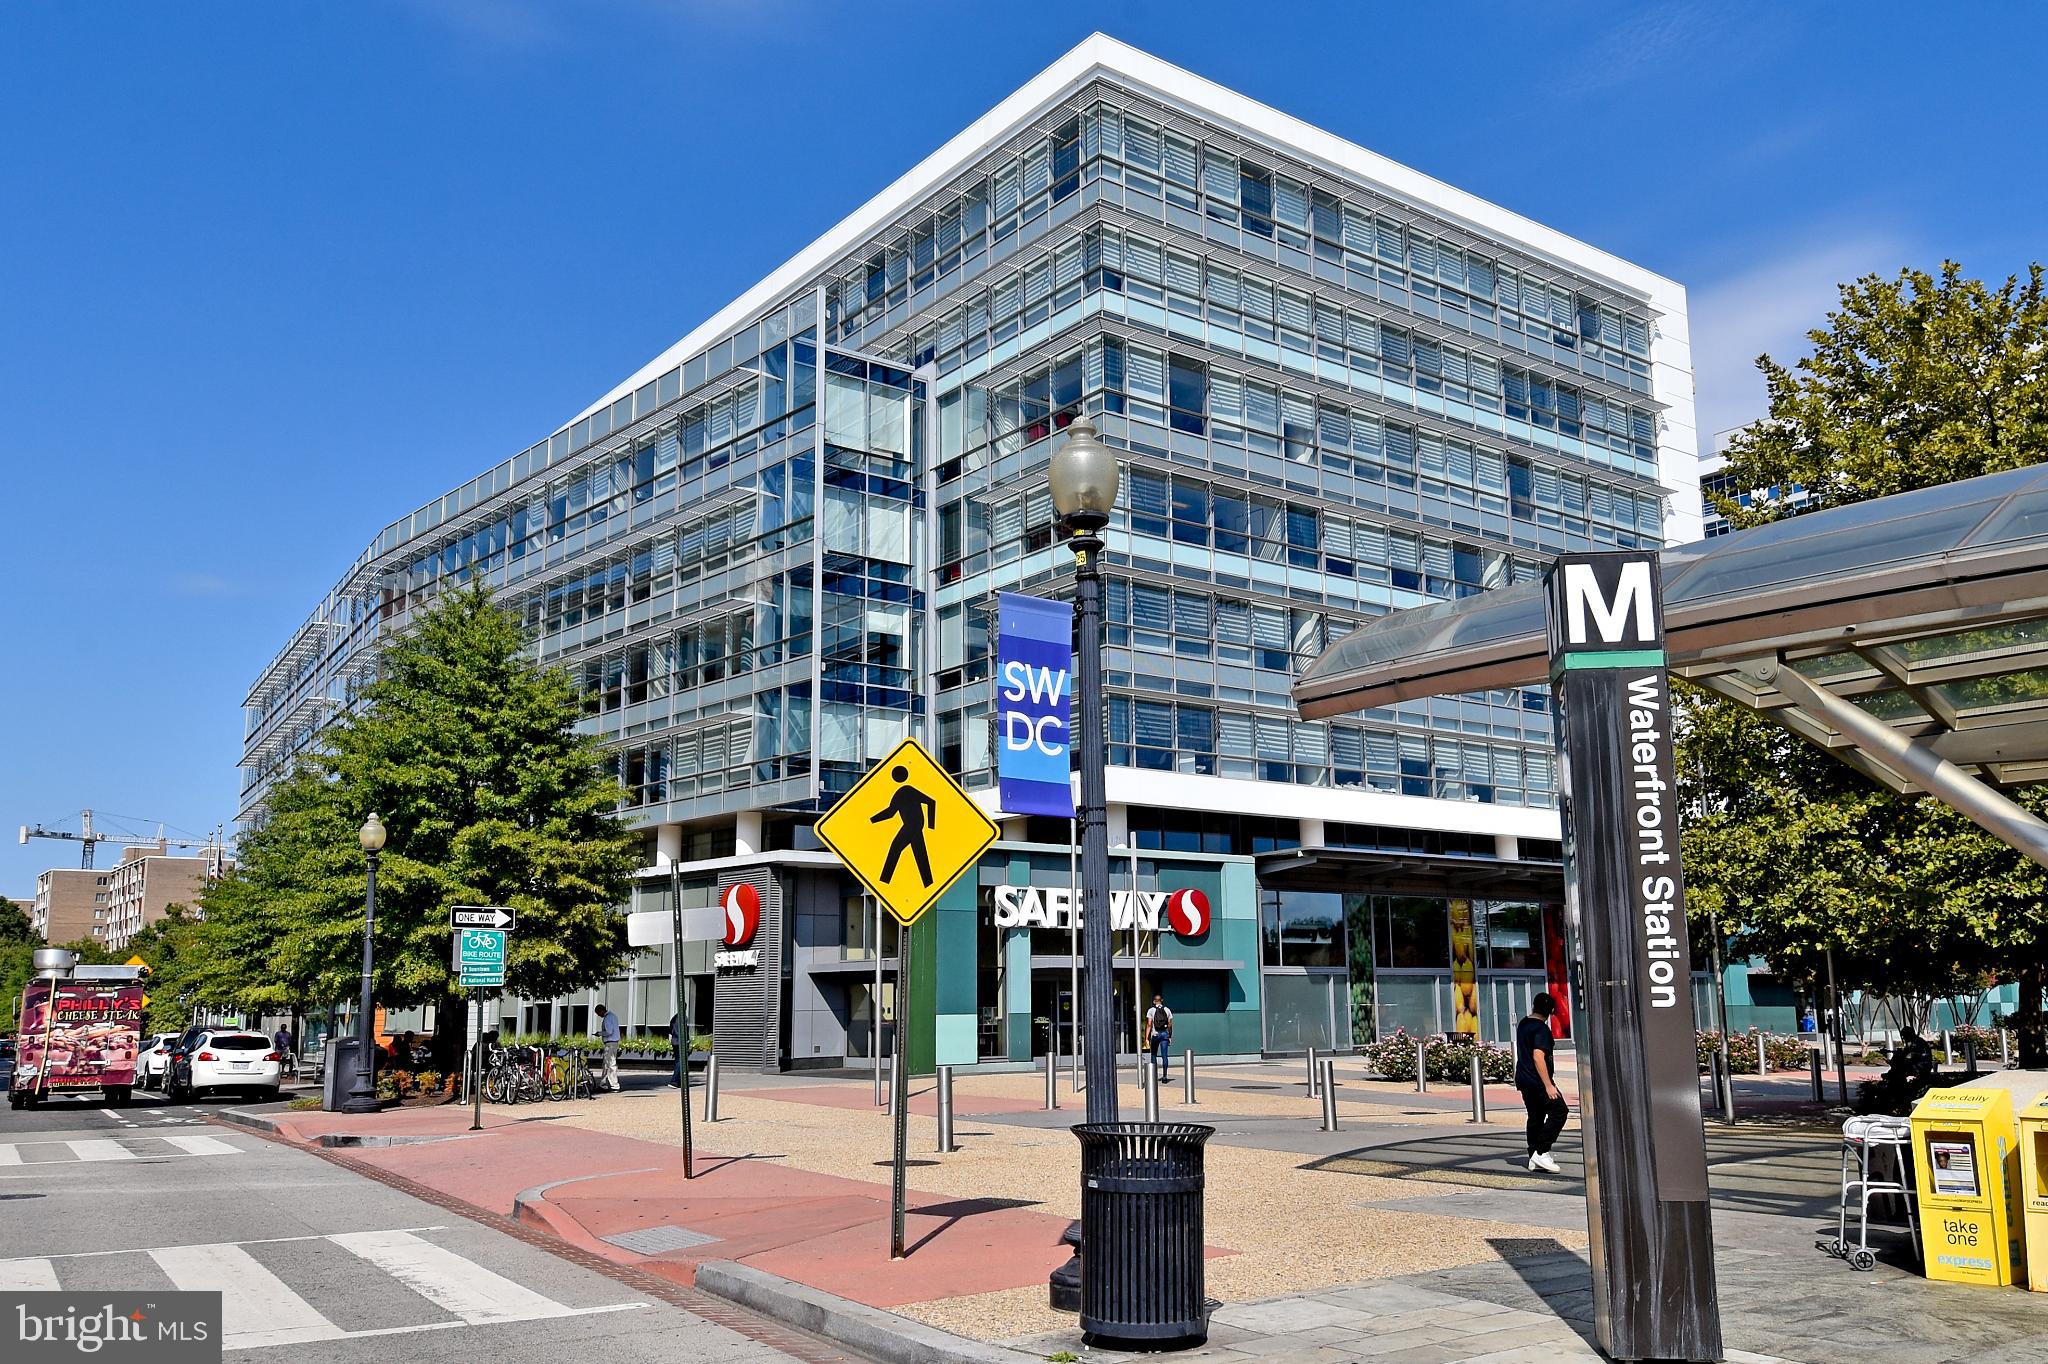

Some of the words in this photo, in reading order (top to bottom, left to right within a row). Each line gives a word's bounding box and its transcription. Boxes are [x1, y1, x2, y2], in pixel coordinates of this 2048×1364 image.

[1565, 562, 1655, 643] M
[1544, 568, 1562, 661] M
[1004, 661, 1066, 707] SW
[1007, 711, 1063, 756] DC
[1628, 675, 1670, 865] Waterfront
[458, 914, 475, 922] ONE
[478, 914, 496, 922] WAY
[1642, 876, 1680, 1008] Station
[58, 997, 141, 1010] PHILLY'S
[57, 1010, 98, 1020] CHEESE
[102, 1010, 140, 1020] STEAK
[1959, 1094, 1990, 1102] daily
[1943, 1218, 1978, 1234] take
[1947, 1234, 1978, 1247] one
[1937, 1255, 1993, 1268] express
